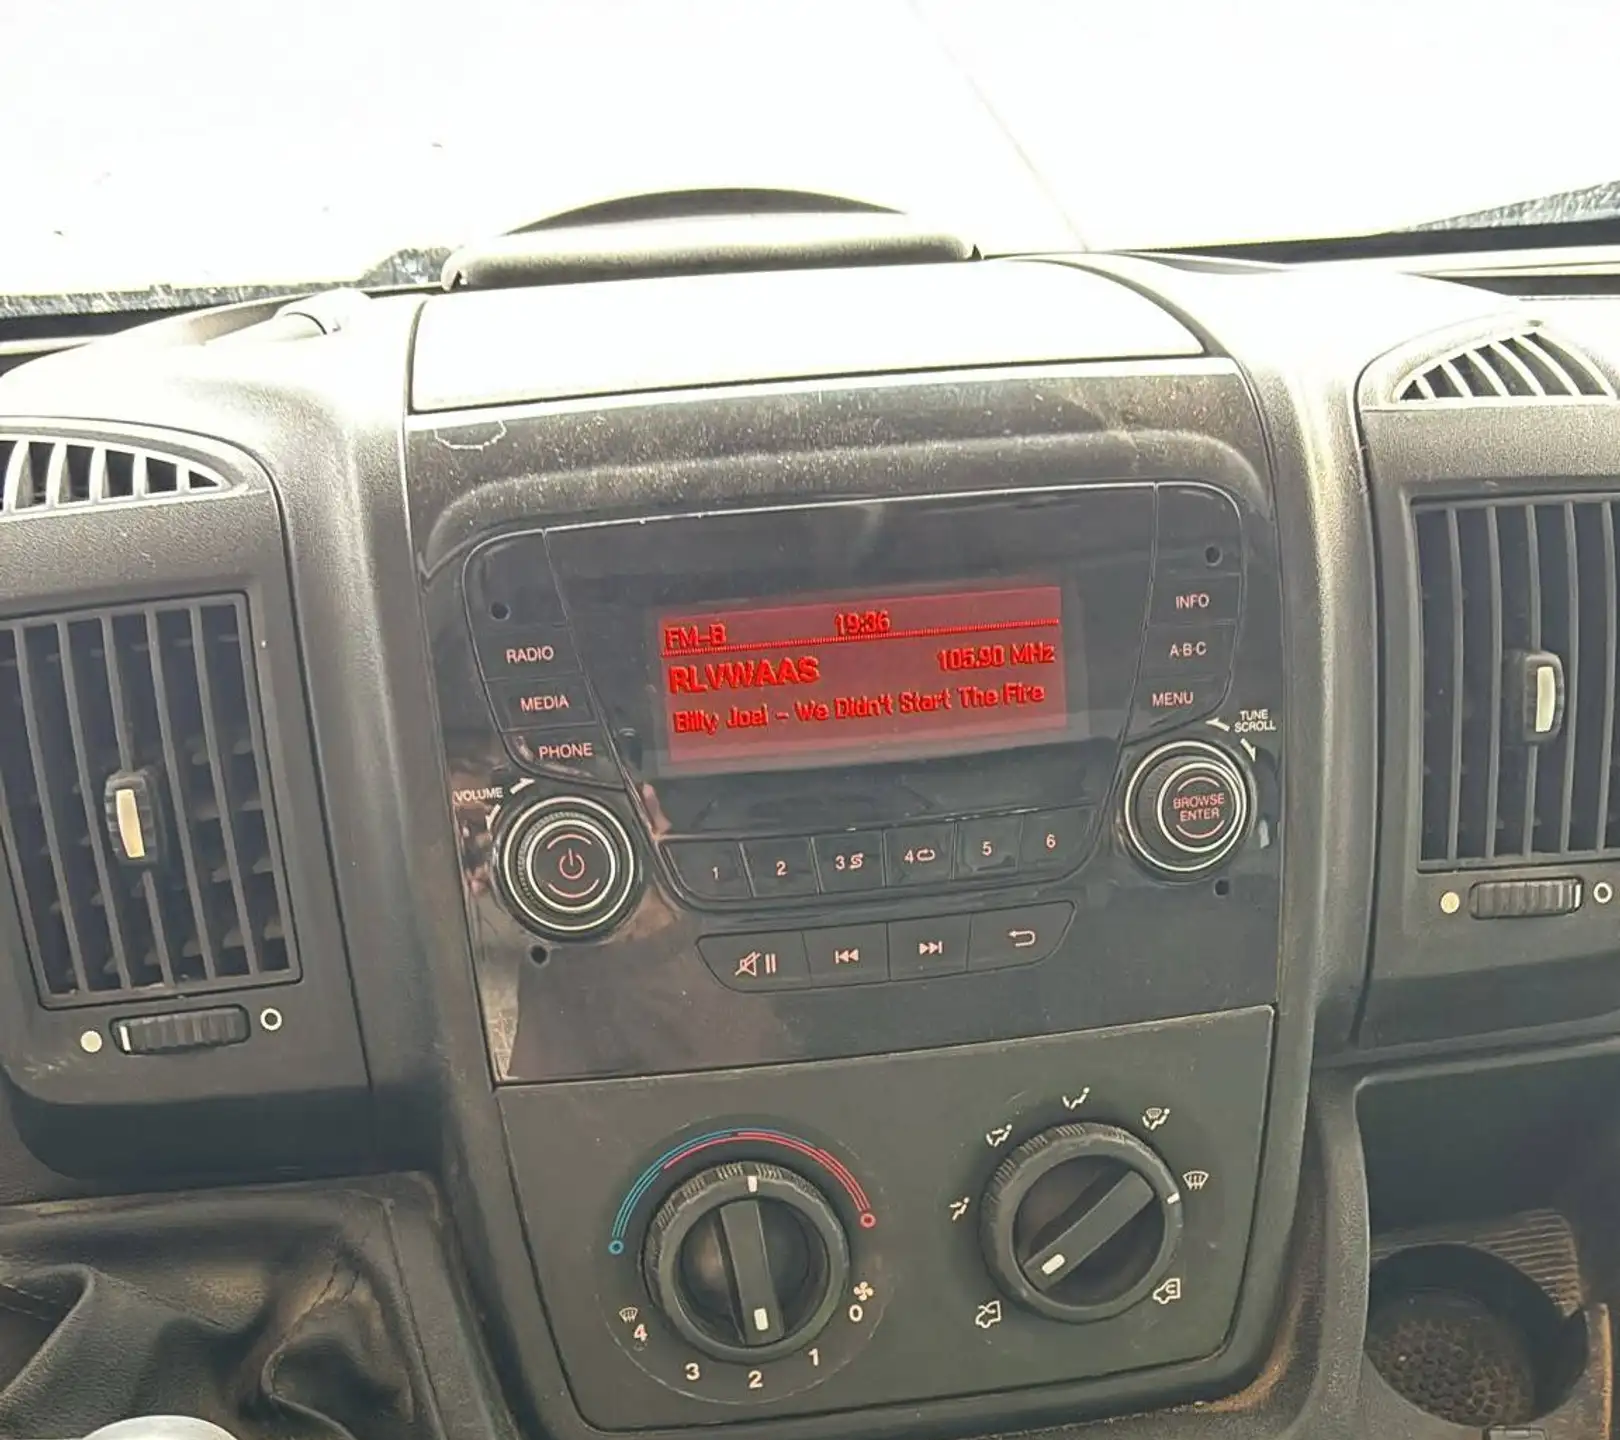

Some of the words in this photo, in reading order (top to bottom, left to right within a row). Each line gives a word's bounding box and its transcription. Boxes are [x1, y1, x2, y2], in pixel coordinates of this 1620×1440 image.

[1175, 593, 1210, 609] INFO
[835, 610, 890, 636] 19:36
[664, 623, 727, 648] FM-B
[505, 645, 554, 664] RADIO
[938, 645, 1005, 671] 105.90
[1010, 641, 1056, 664] MHz
[669, 655, 821, 694] RLVWAAS
[519, 694, 570, 712] MEDIA
[1151, 691, 1194, 707] MENU
[673, 709, 720, 735] Billy
[726, 703, 769, 728] Joel
[794, 700, 830, 721] We
[834, 693, 893, 719] Didn't
[899, 687, 953, 714] Start
[958, 684, 998, 709] The
[1003, 681, 1046, 706] Fire
[1240, 708, 1268, 721] TUNE
[1234, 720, 1276, 733] SCROLL
[538, 743, 594, 760] PHONE
[454, 787, 504, 802] VOLUME
[1172, 792, 1225, 809] BROWSE
[1180, 807, 1220, 822] ENTER
[982, 841, 993, 856] 5
[1046, 833, 1056, 849] 6
[835, 855, 845, 870] 3
[904, 850, 914, 863] 4
[712, 866, 720, 880] 1
[776, 861, 788, 876] 2
[849, 1304, 864, 1323] 0
[633, 1323, 648, 1342] 4
[808, 1348, 820, 1367] 1
[685, 1362, 700, 1381] 3
[748, 1370, 763, 1389] 2
